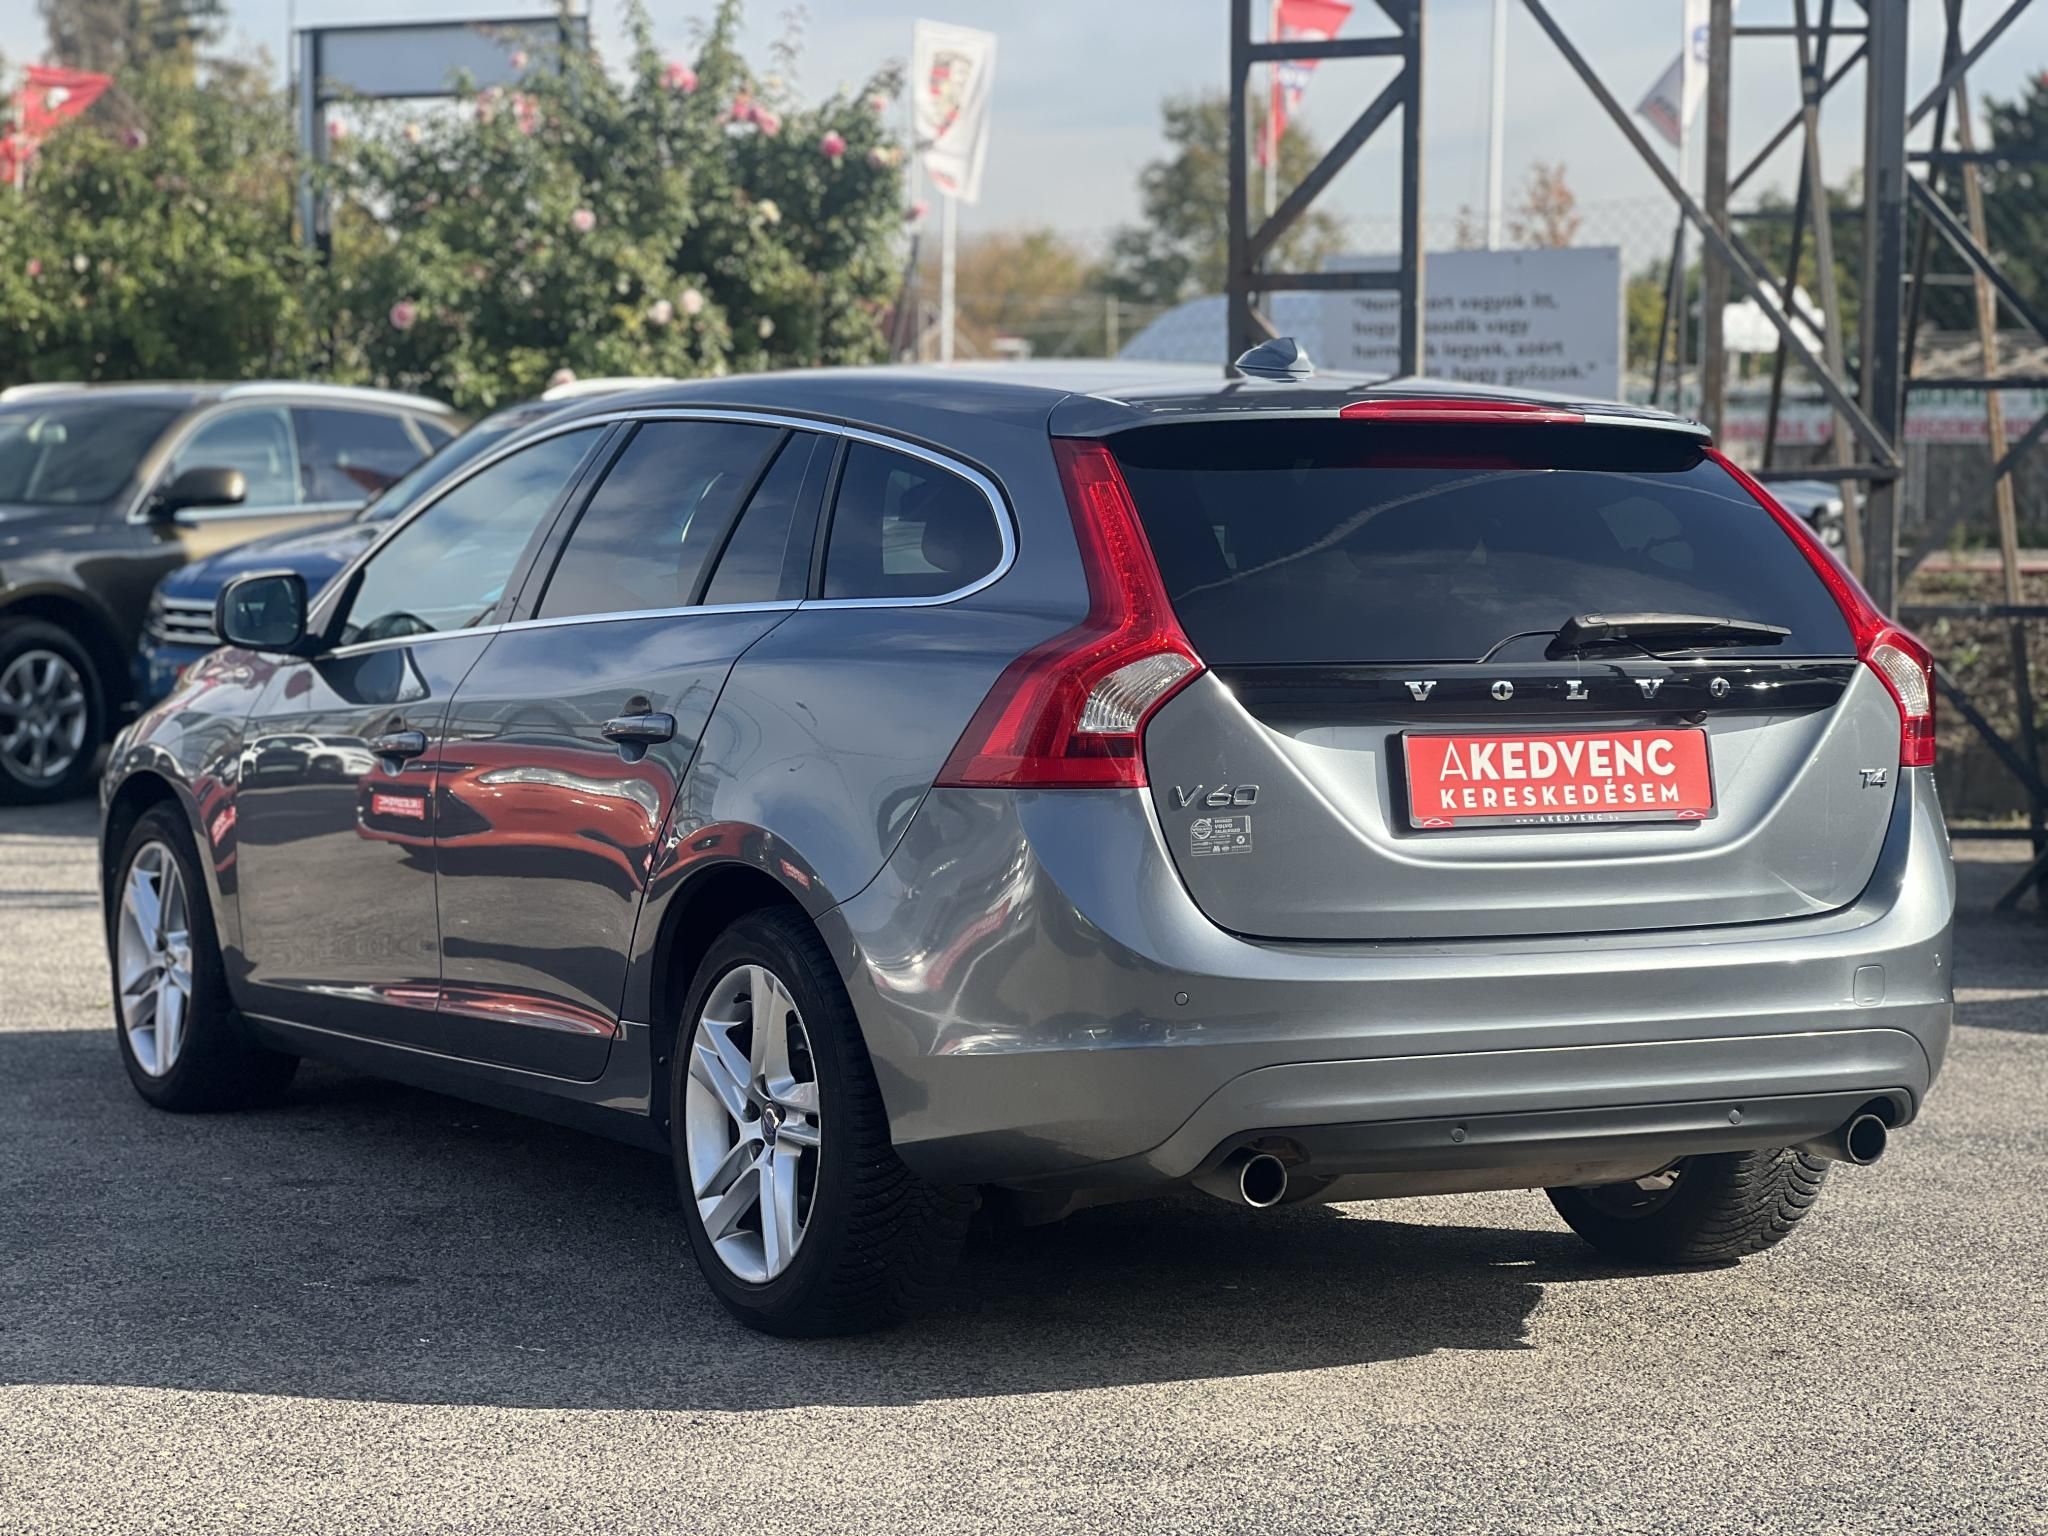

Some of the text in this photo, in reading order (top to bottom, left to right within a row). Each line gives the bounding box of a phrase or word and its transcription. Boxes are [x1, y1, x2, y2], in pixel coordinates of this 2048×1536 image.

[1405, 676, 1731, 701] VOLVO
[1859, 767, 1887, 789] T4
[1175, 783, 1260, 807] V60
[1440, 778, 1680, 809] KERESKEDÉSEM
